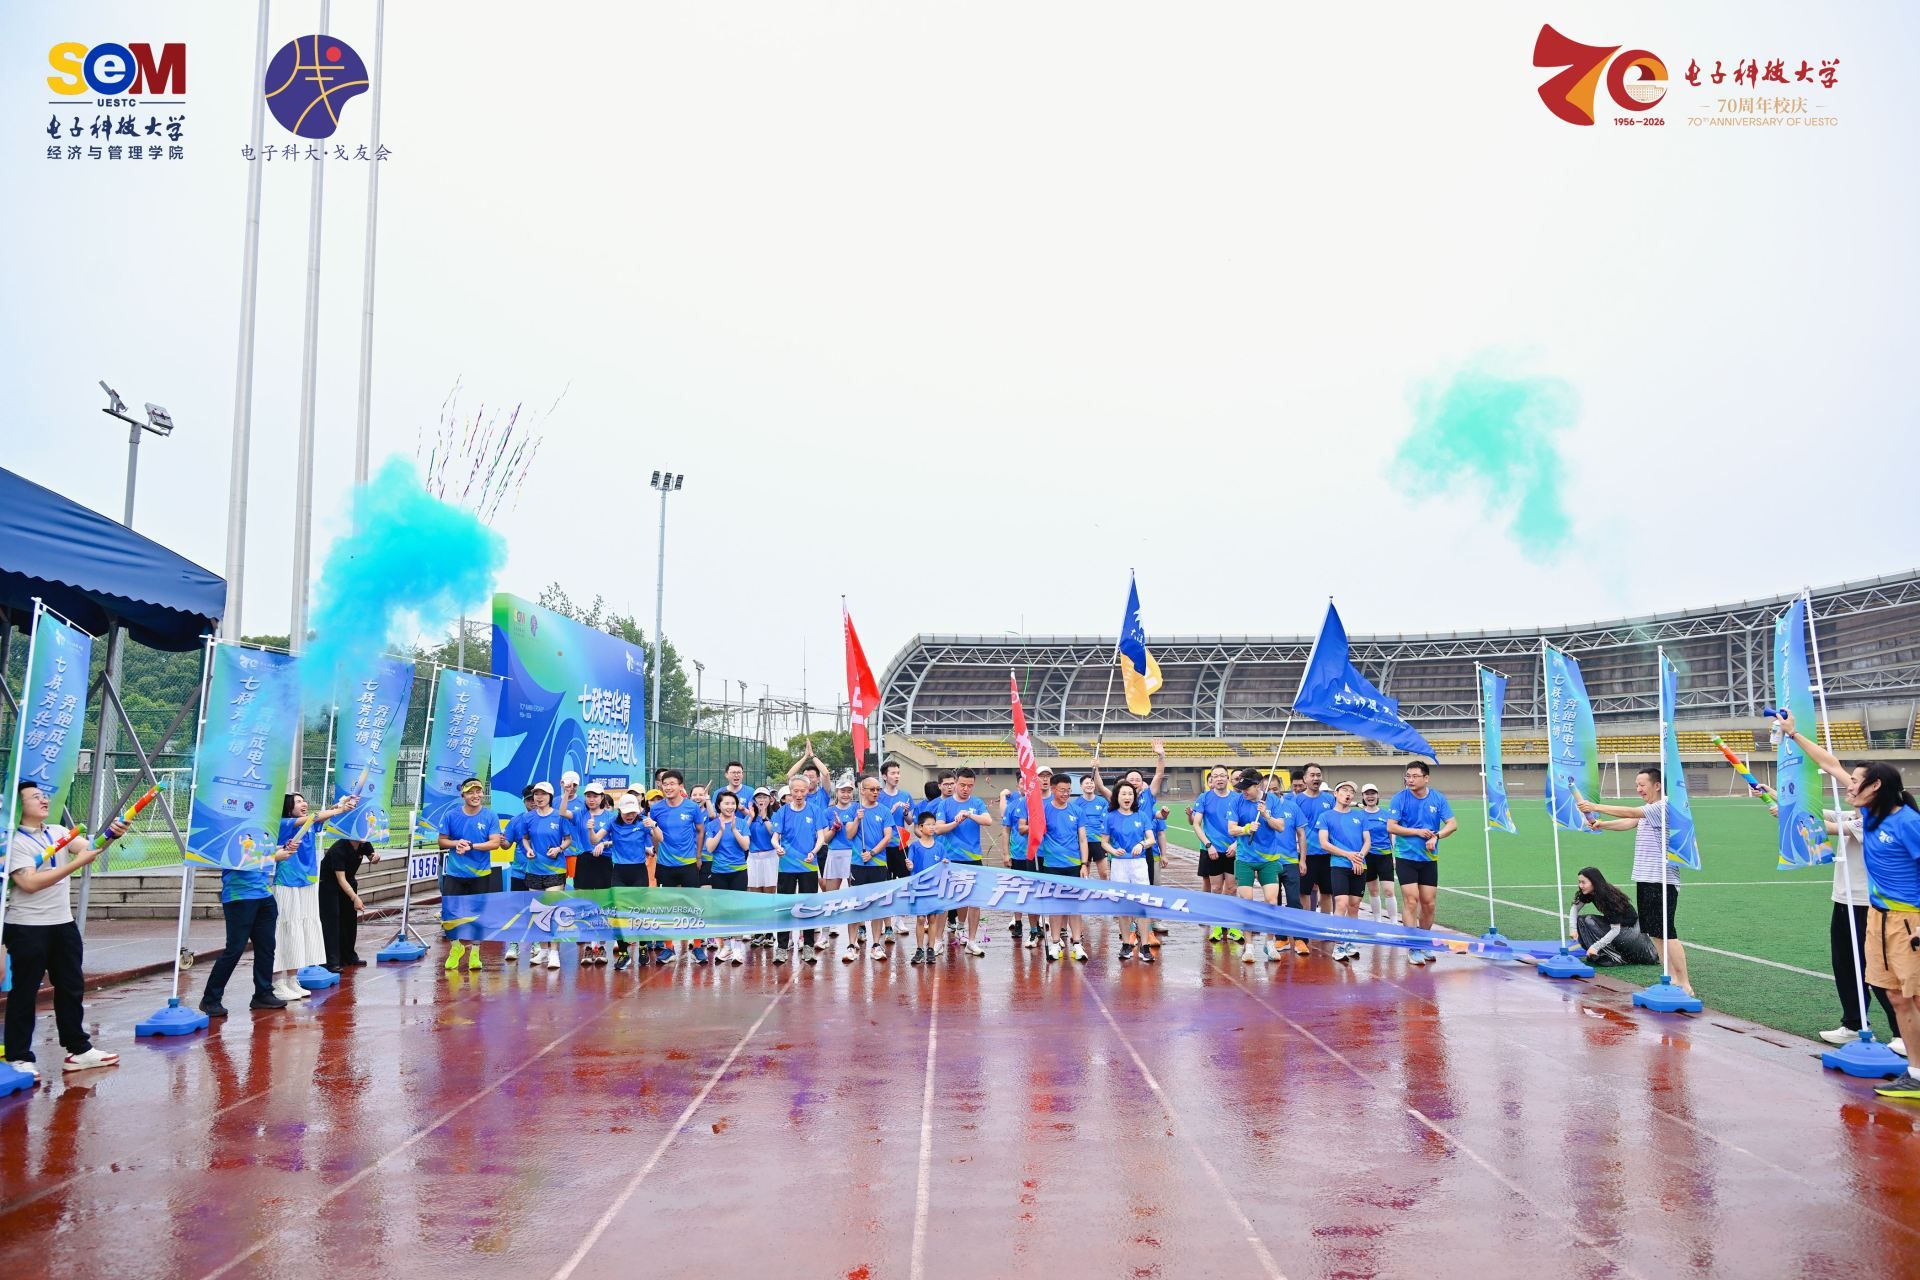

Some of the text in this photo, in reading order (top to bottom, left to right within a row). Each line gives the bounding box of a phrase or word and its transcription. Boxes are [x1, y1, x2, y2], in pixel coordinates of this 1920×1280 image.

[578, 683, 632, 733] 七秩芳华情
[28, 693, 79, 781] 奔跑成电人
[584, 727, 638, 775] 奔跑成电人
[412, 856, 438, 879] 1956
